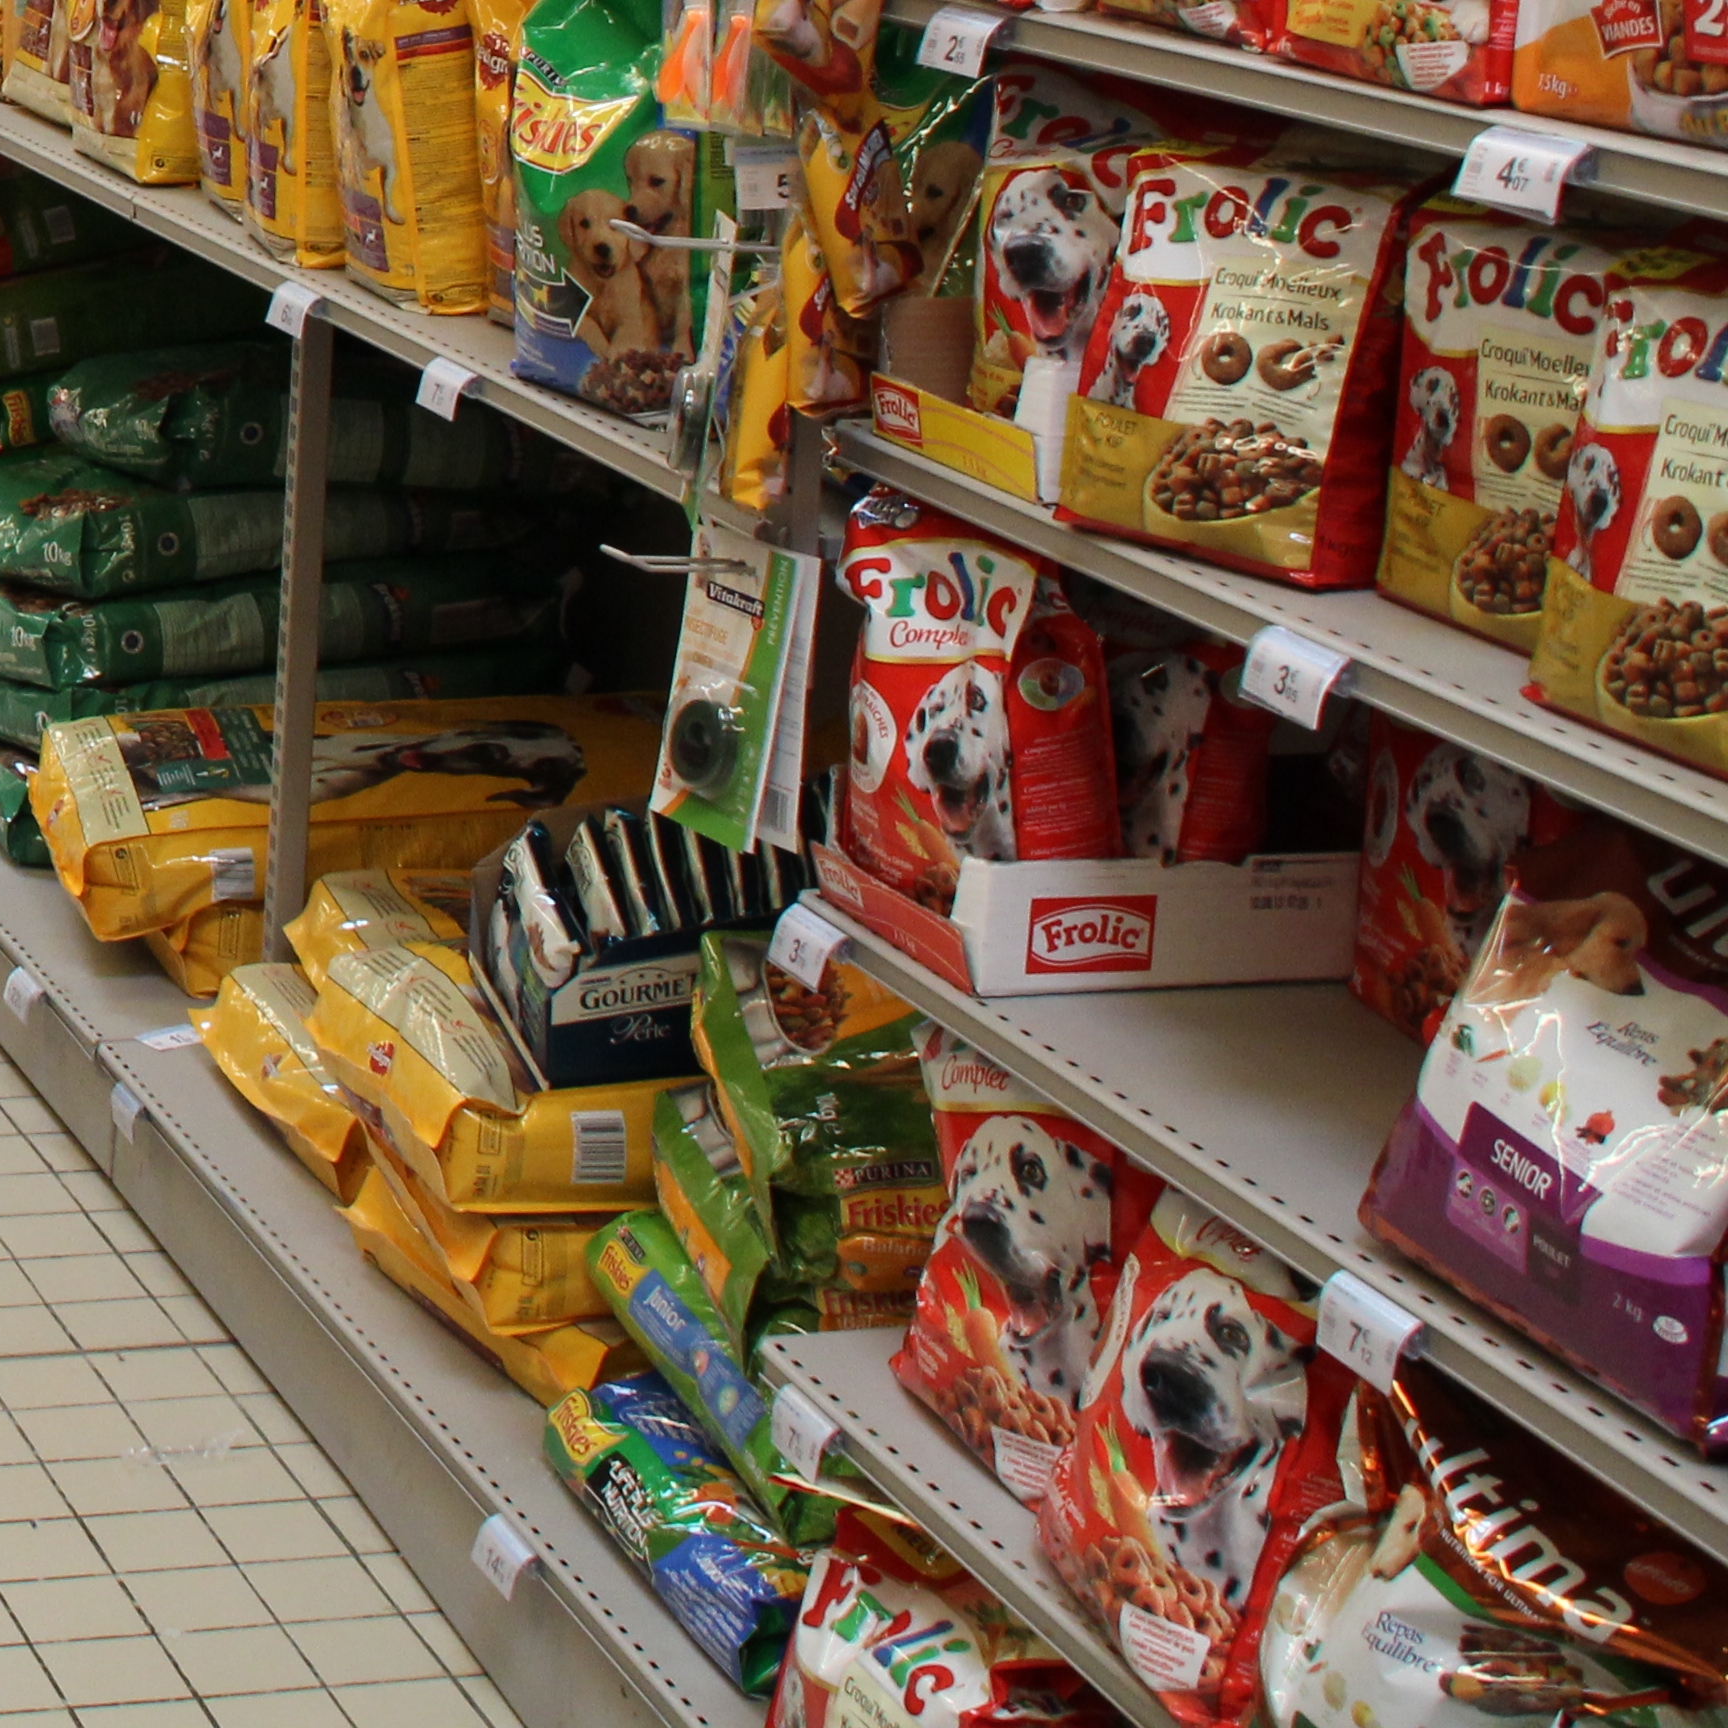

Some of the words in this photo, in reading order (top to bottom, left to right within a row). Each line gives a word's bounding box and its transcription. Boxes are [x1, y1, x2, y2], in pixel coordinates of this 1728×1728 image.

[1601, 15, 1656, 43] VIANDES
[1127, 176, 1354, 260] Frolic
[1417, 230, 1605, 336] Frolic
[875, 391, 920, 433] Frolic
[707, 580, 765, 618] Vitakraft
[765, 557, 792, 648] PRÉVENTION
[842, 551, 1024, 637] Frolic
[1039, 909, 1141, 956] Frolic
[610, 1012, 674, 1047] Perle
[1619, 1019, 1661, 1047] Repas
[851, 1163, 933, 1186] PURINA
[1491, 1137, 1554, 1201] SENIOR
[599, 1243, 633, 1292] Friskies
[1530, 1232, 1573, 1269] POULET
[643, 1288, 686, 1332] Junior
[1612, 1289, 1623, 1307] 2
[1624, 1295, 1643, 1323] kg
[553, 1393, 595, 1455] Friskies
[600, 1482, 647, 1547] NUTRITION
[1439, 1528, 1486, 1582] NUTRITION
[1374, 1610, 1425, 1646] Repas
